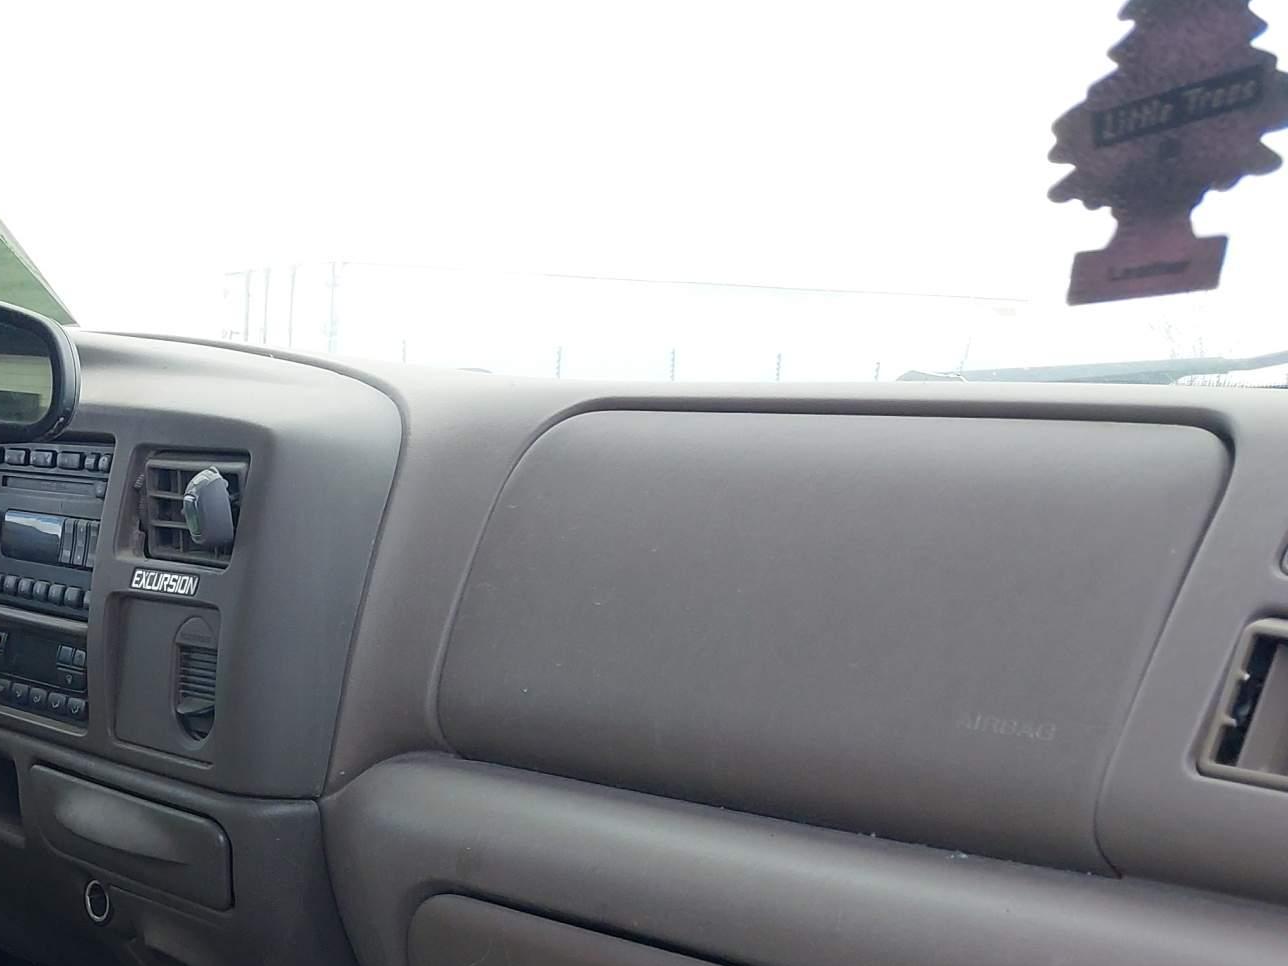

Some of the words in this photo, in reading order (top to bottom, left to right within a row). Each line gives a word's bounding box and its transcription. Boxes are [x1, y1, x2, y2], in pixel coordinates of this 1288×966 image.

[1103, 98, 1175, 139] Little
[1183, 80, 1257, 115] Trees
[131, 569, 198, 595] EXCURSION
[954, 711, 1057, 741] AIRBAG
